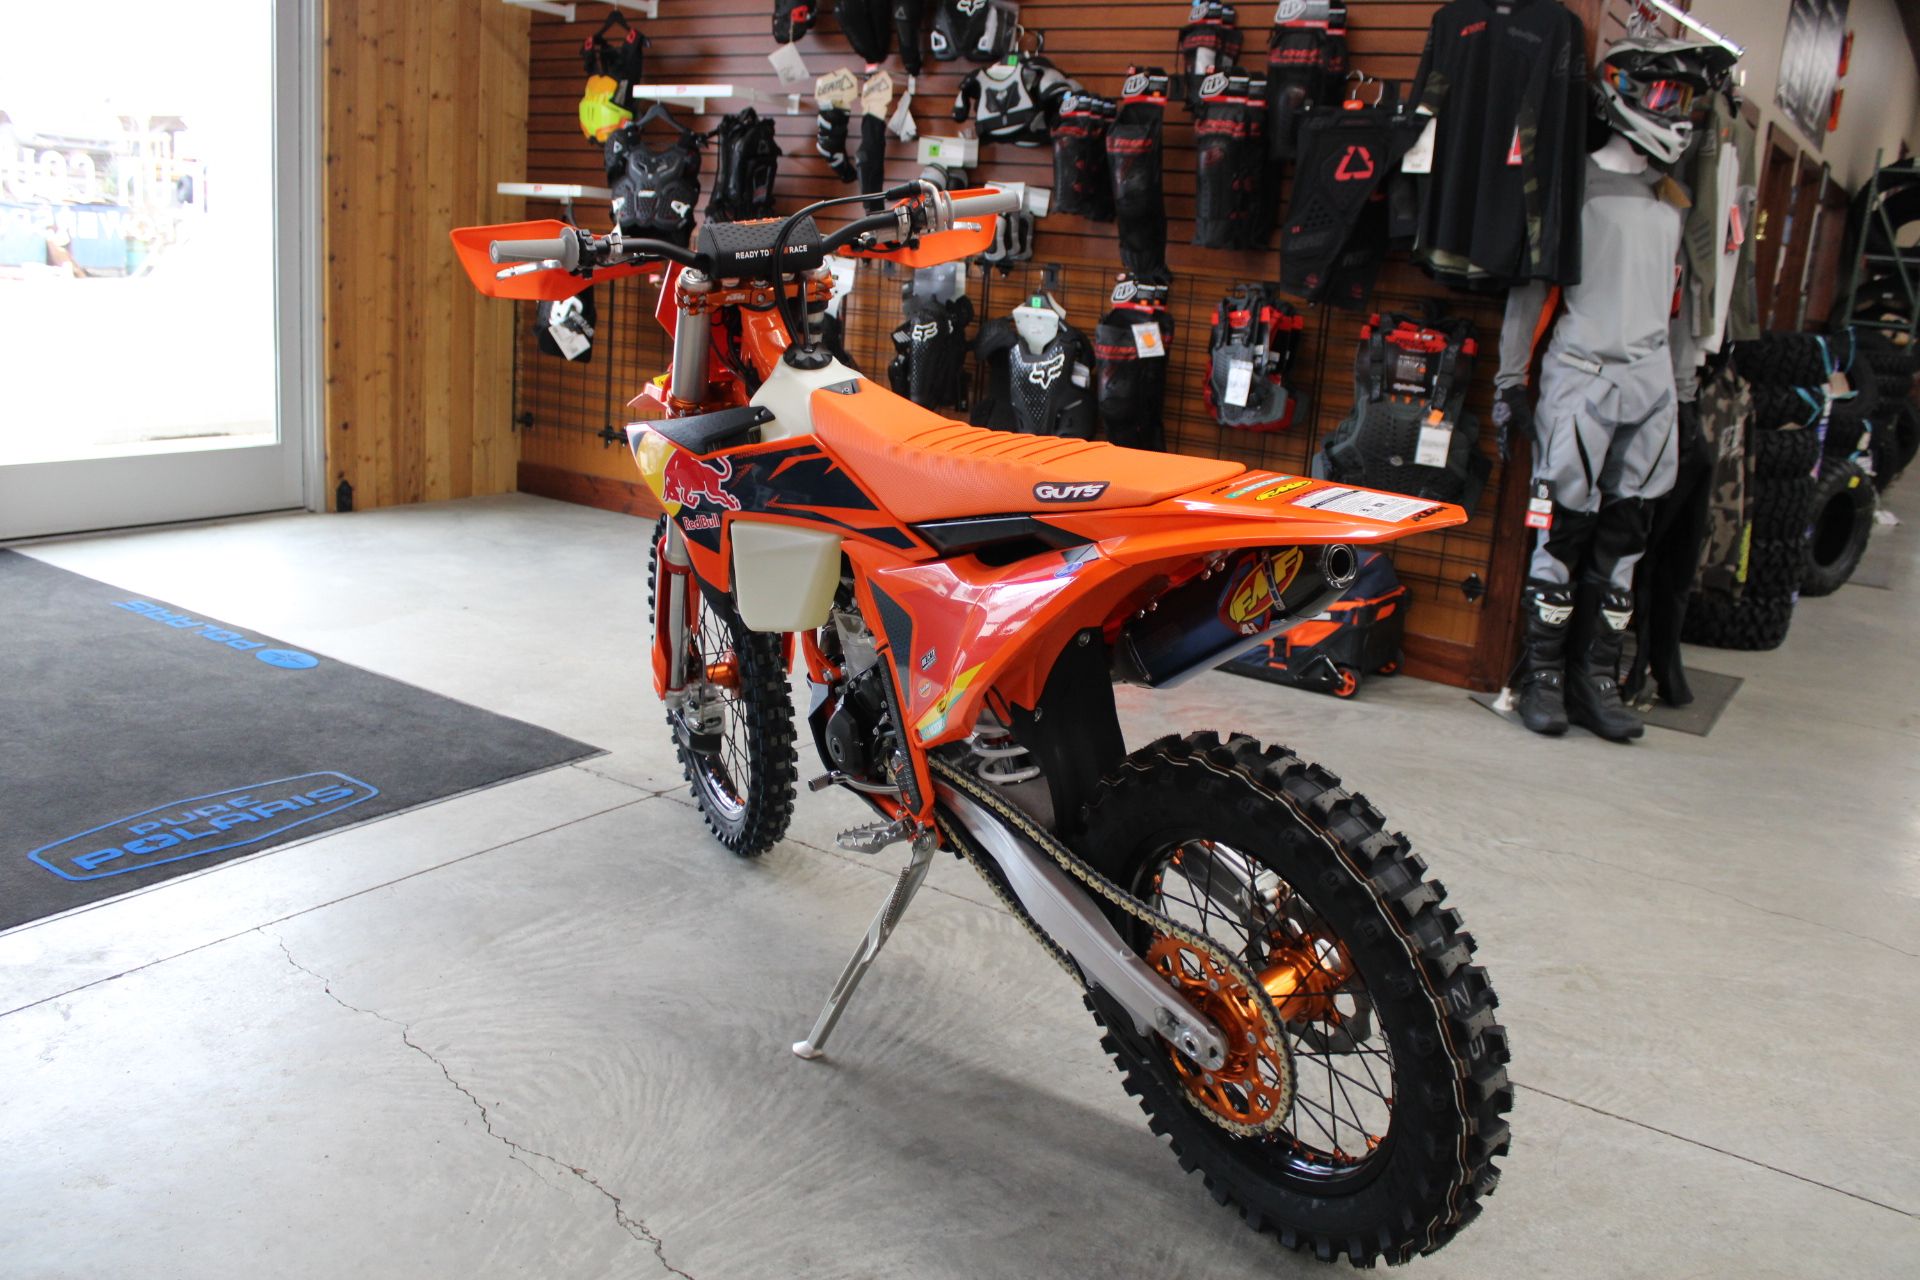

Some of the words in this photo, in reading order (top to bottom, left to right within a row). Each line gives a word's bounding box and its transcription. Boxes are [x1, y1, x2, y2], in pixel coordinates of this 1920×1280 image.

[735, 250, 759, 260] READY
[760, 248, 770, 257] TO
[788, 244, 808, 254] RACE
[1035, 484, 1105, 499] GUTS
[1231, 545, 1300, 624] FMF
[112, 600, 266, 650] POLARIS
[71, 784, 356, 872] POLARIS
[128, 794, 263, 836] PURE
